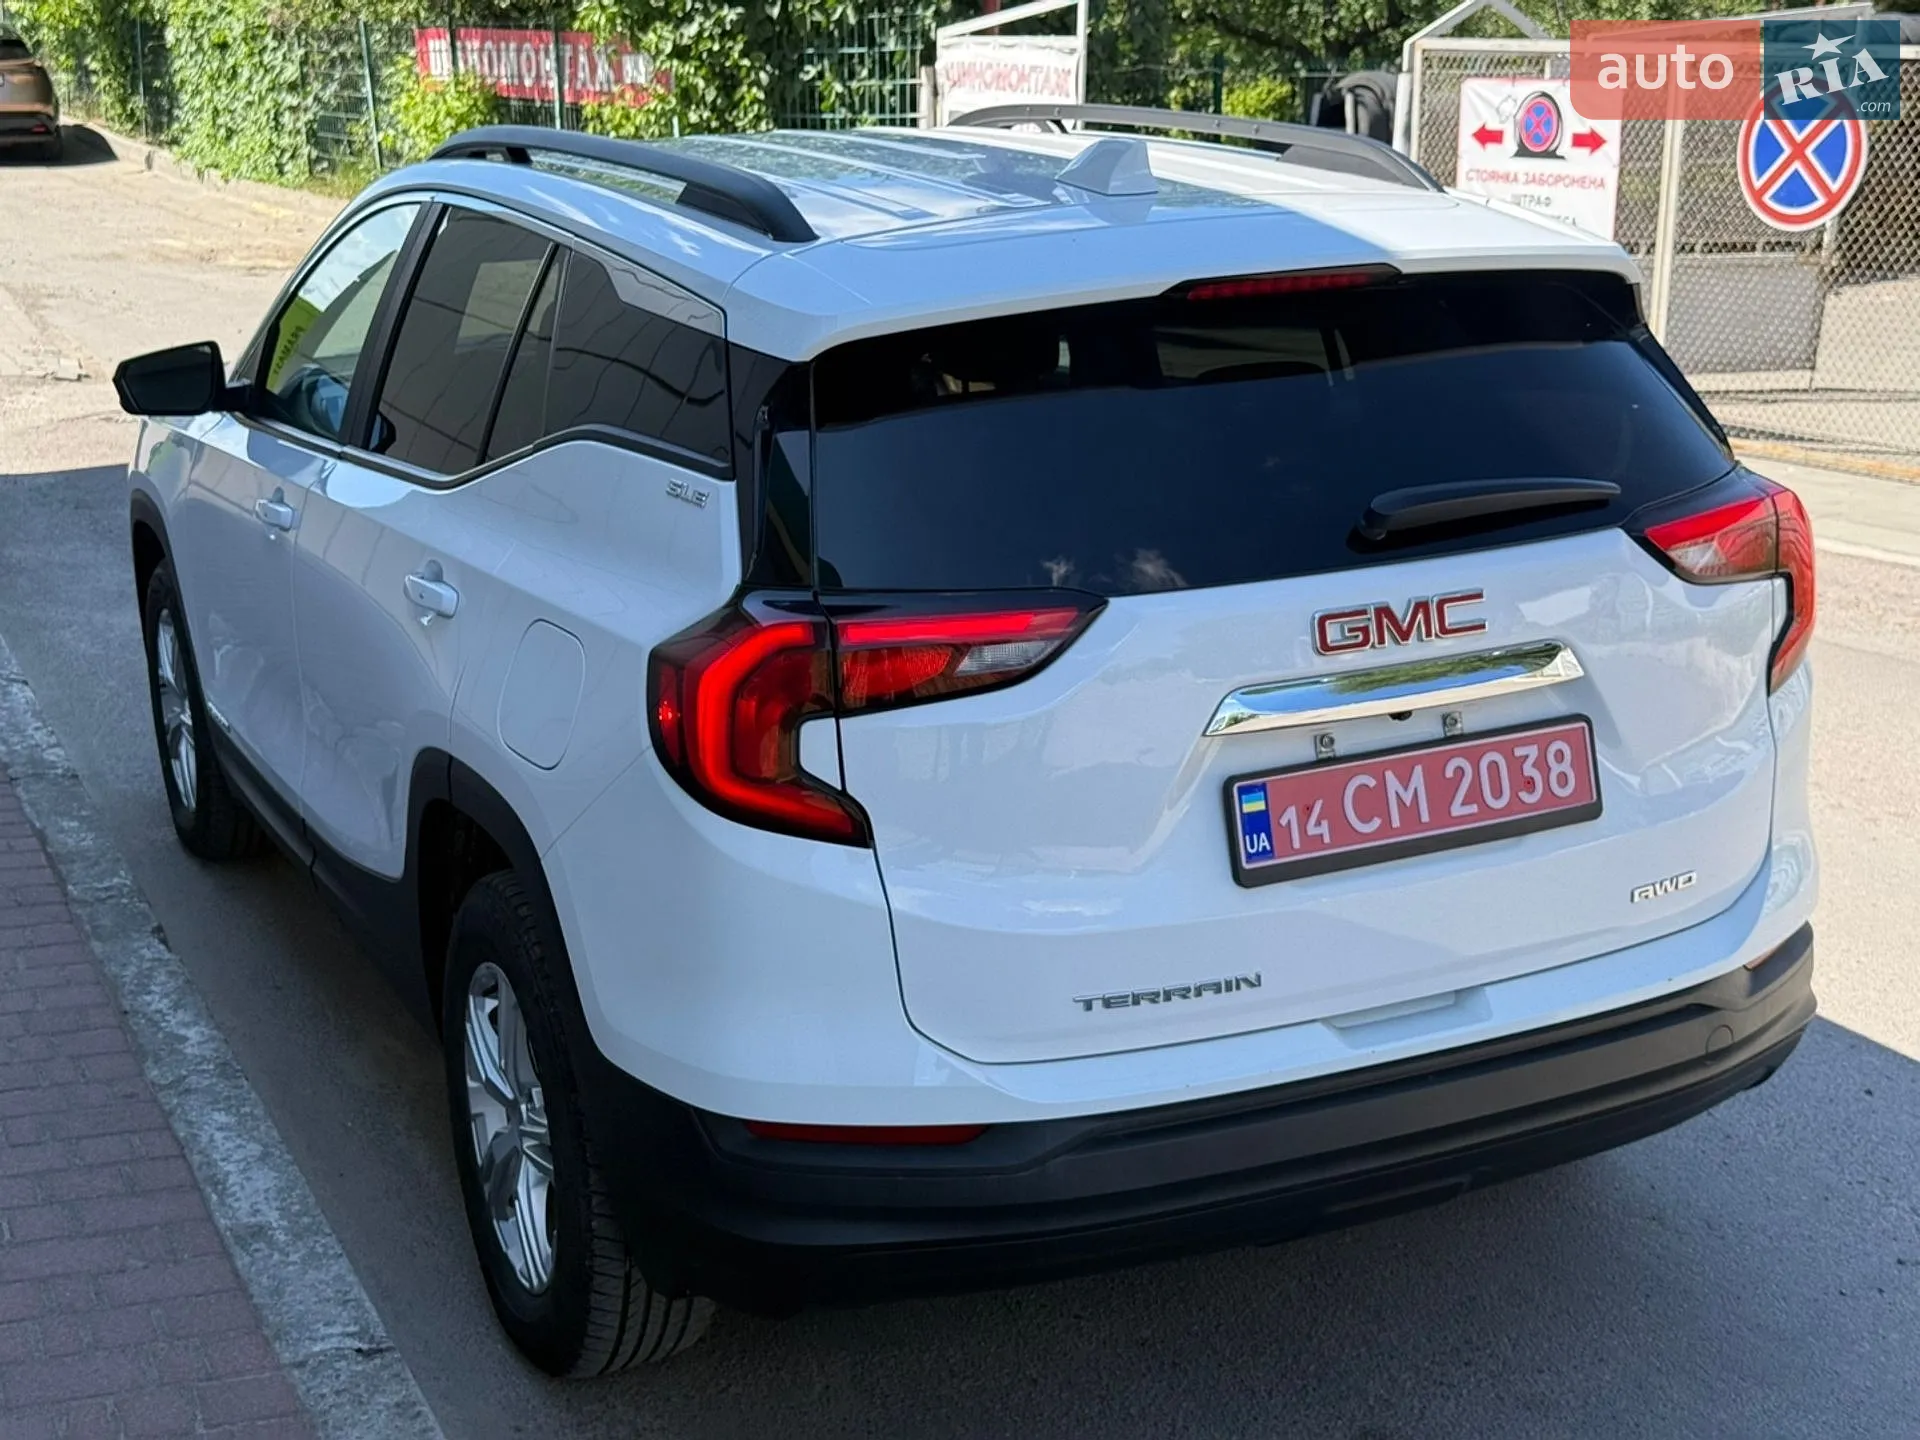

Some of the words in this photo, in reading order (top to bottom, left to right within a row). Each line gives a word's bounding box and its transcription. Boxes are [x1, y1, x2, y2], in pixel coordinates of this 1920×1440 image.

[1465, 169, 1518, 184] СТОЯНКА
[1522, 172, 1605, 189] ЗАБОРОНЕНА
[1311, 588, 1488, 655] GMC
[1279, 799, 1330, 849] 14
[1343, 764, 1429, 834] CM
[1445, 740, 1575, 817] 2038
[1245, 832, 1271, 854] UA
[1631, 869, 1696, 903] AWD
[1072, 972, 1261, 1011] TERRAIN
